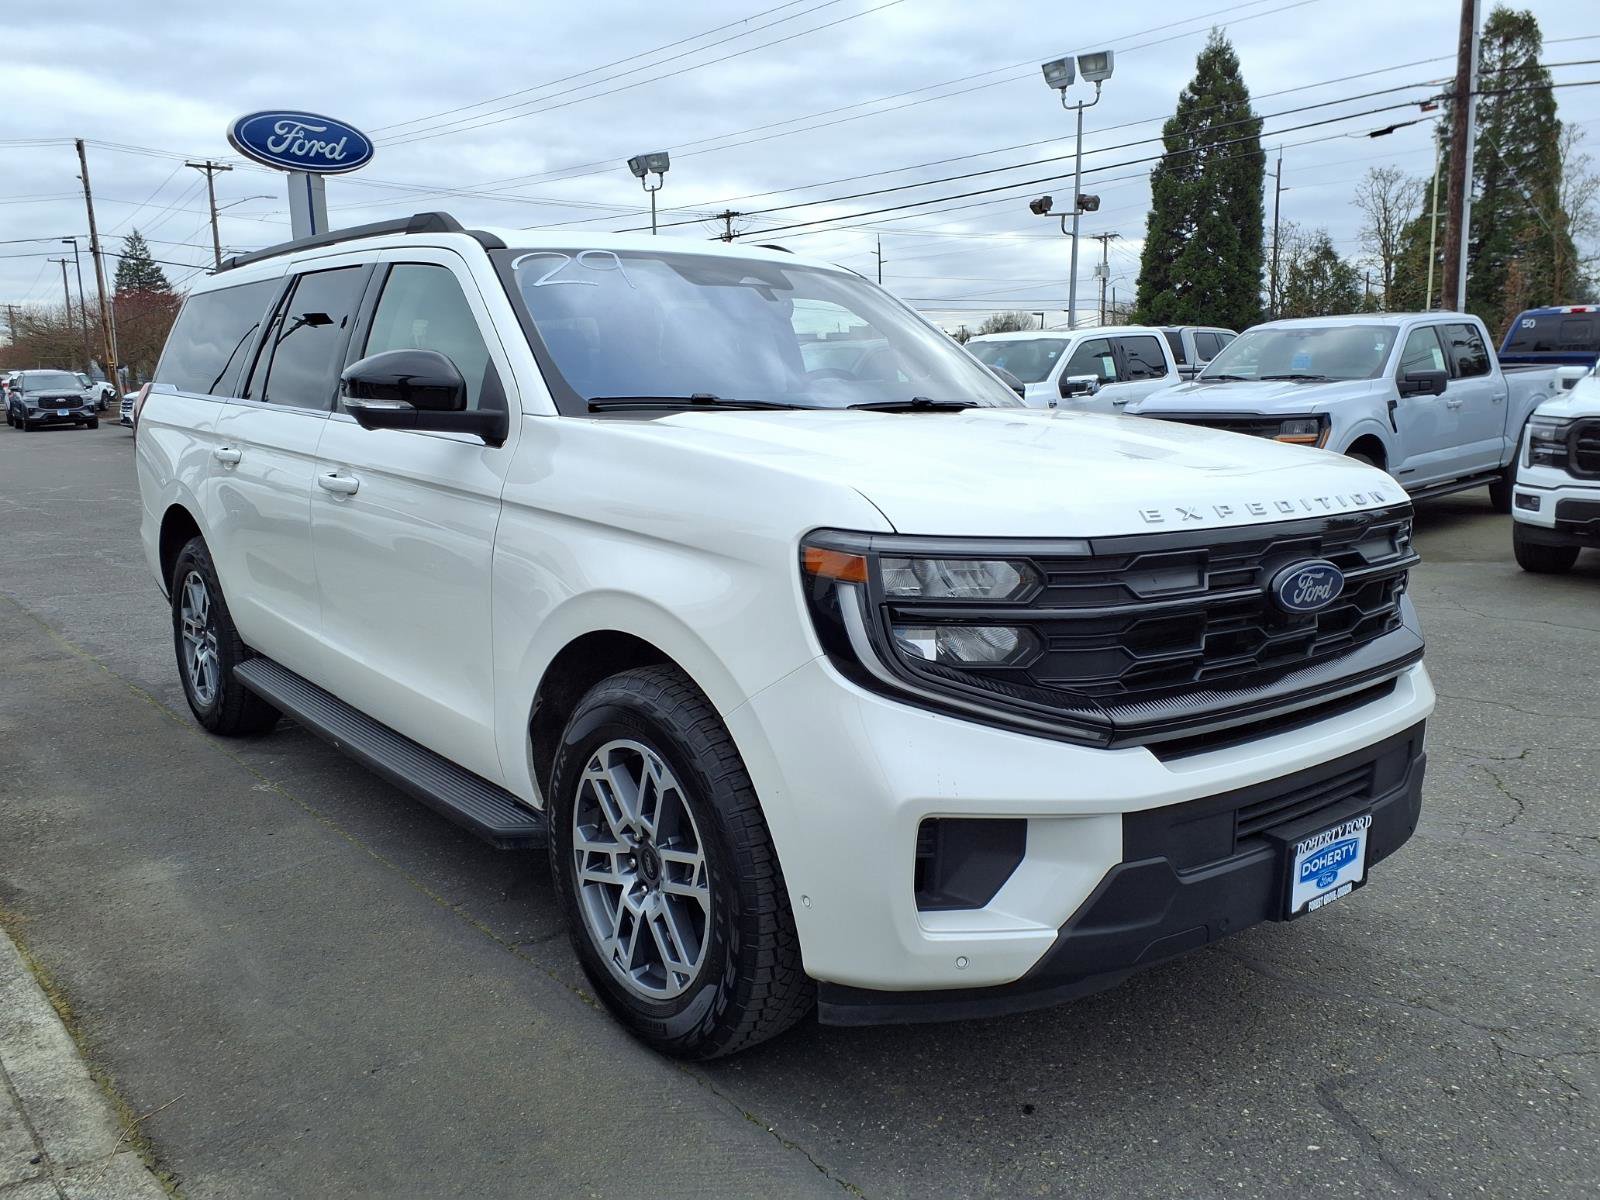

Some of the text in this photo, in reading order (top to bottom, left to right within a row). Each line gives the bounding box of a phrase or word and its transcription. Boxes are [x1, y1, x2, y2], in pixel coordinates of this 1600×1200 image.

[267, 119, 347, 161] Ford
[510, 249, 637, 290] 29
[1138, 490, 1386, 524] EXPEDITION
[1293, 572, 1334, 604] Ford
[1297, 815, 1373, 857] DOHERTY FORD
[1301, 842, 1357, 877] DOHERTY
